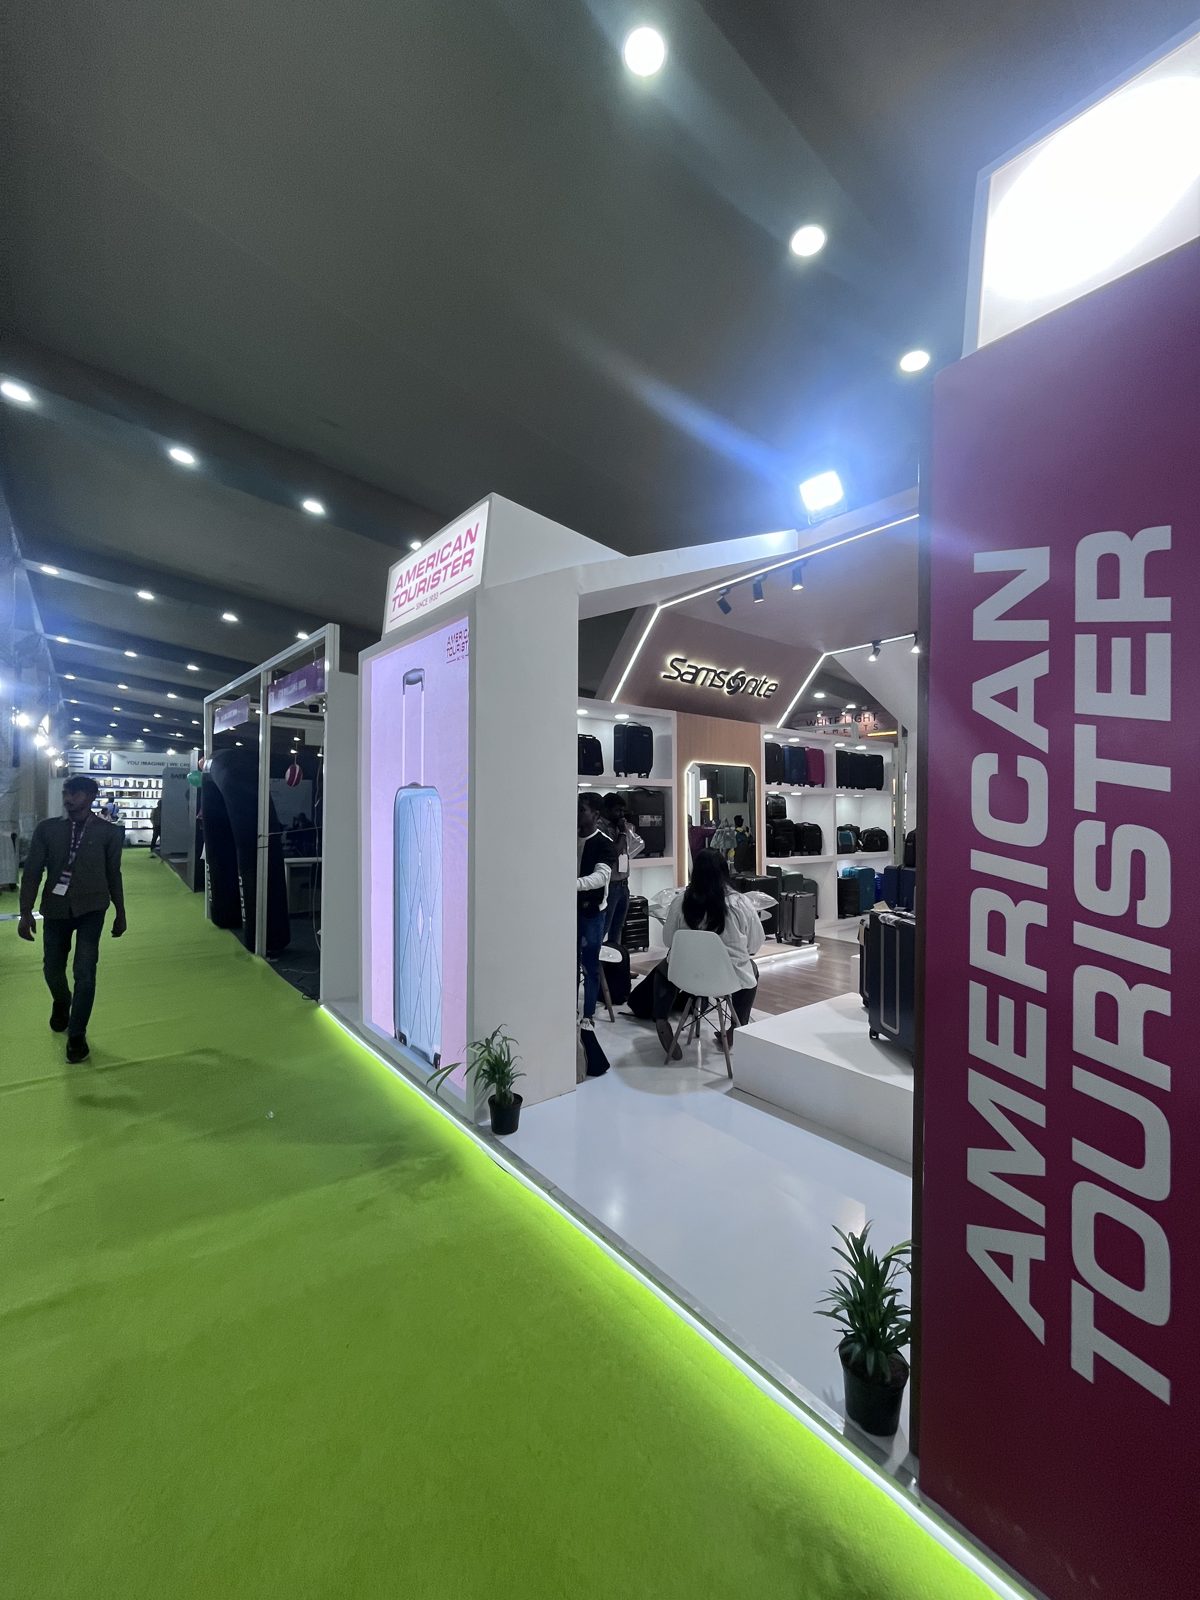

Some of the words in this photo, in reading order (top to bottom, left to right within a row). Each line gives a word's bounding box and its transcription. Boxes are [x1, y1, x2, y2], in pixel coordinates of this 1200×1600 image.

[391, 547, 476, 612] TOURISTER
[393, 522, 480, 594] AMERICAN
[662, 657, 779, 699] Samsonite
[966, 545, 1051, 1346] AMERICAN
[1070, 524, 1172, 1407] TOURISTER
